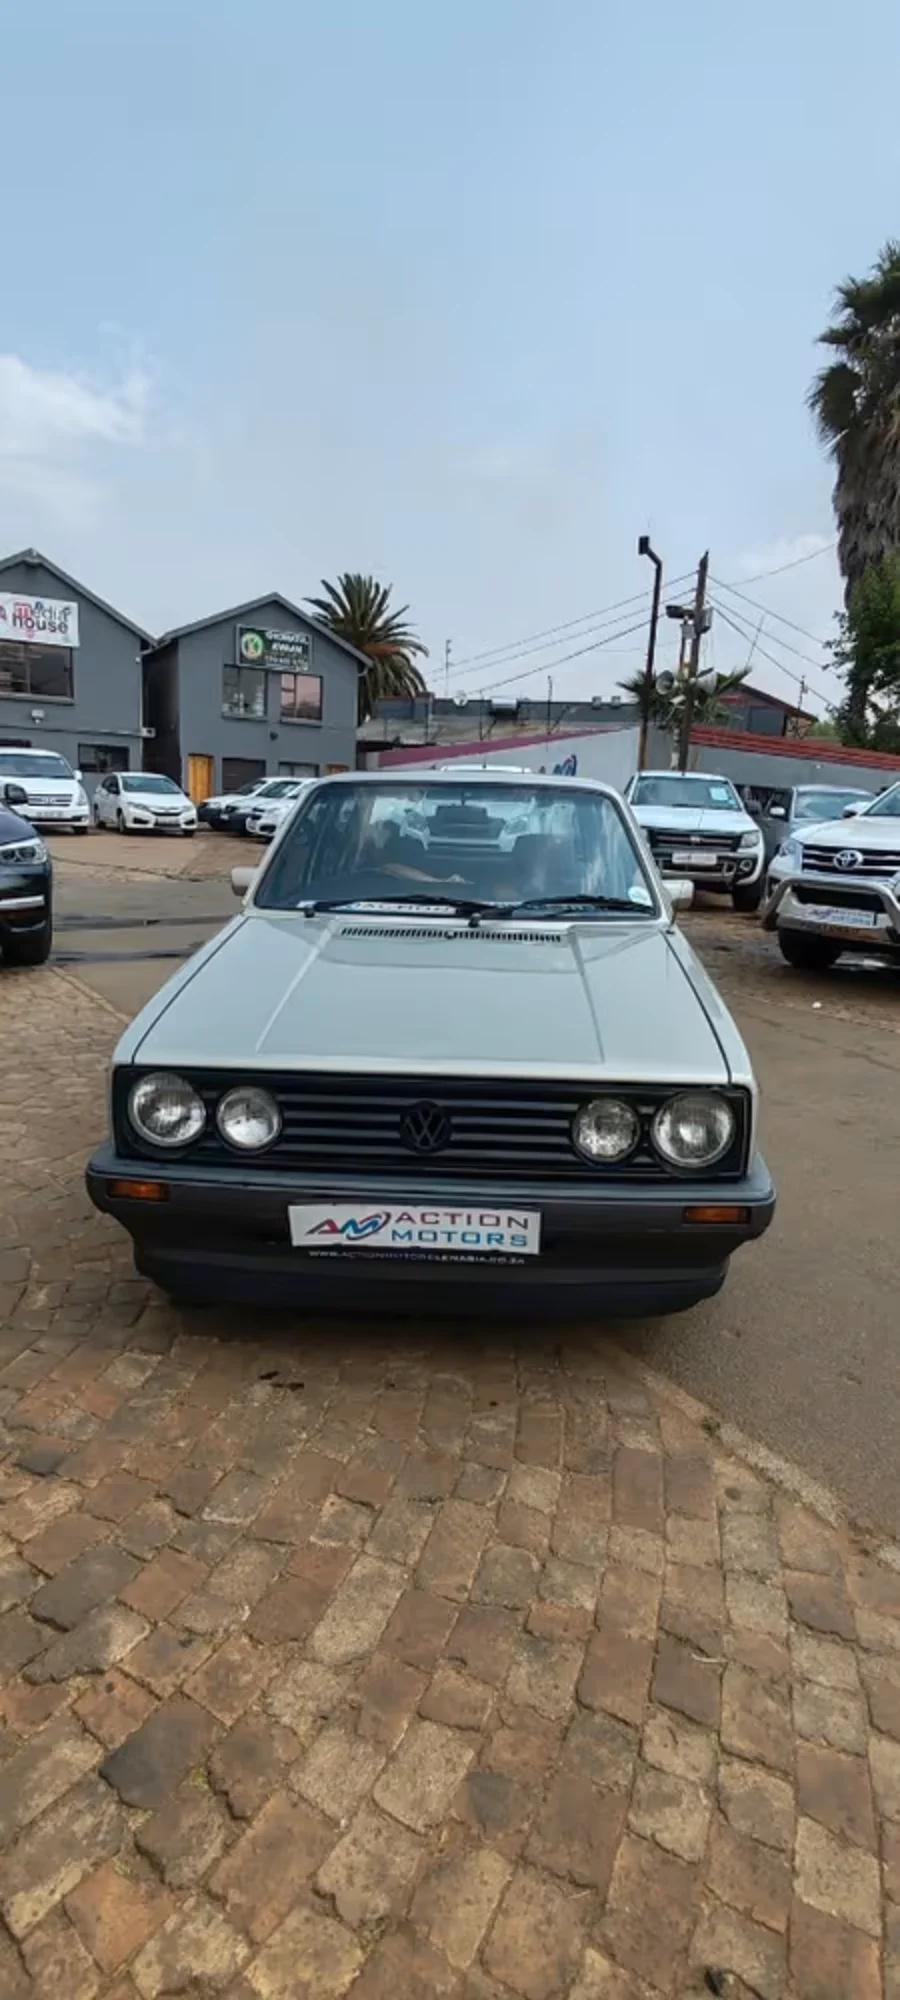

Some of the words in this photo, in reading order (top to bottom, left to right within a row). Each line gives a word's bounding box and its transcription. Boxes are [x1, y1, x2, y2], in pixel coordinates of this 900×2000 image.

[12, 611, 69, 635] house
[395, 1211, 528, 1231] ACTION
[391, 1229, 528, 1247] MOTORS
